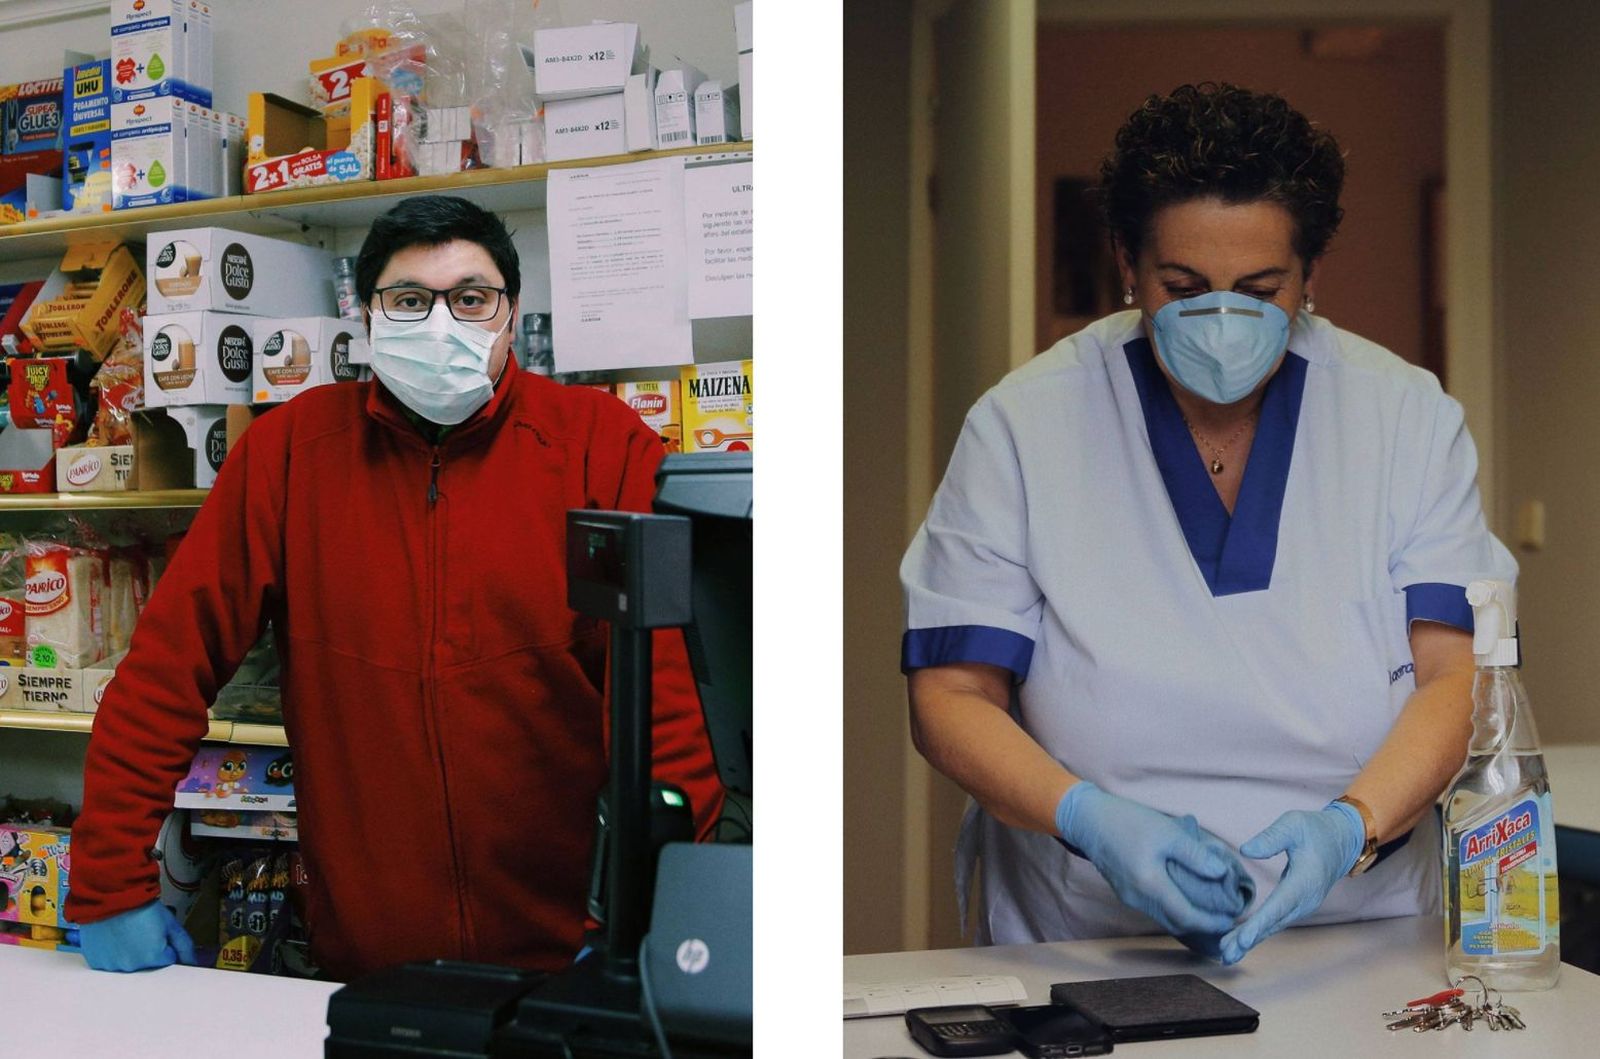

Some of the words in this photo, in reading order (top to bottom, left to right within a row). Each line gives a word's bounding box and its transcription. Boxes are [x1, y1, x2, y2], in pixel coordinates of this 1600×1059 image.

[588, 50, 605, 62] x12
[17, 79, 64, 97] LOCTITE
[76, 79, 99, 95] UHU
[73, 108, 105, 122] UNIVERSAL
[594, 120, 610, 131] x12
[253, 159, 290, 192] 2x1
[292, 161, 323, 176] GRATIS
[338, 162, 360, 175] SAL
[225, 262, 249, 279] Dolce
[225, 275, 250, 289] Gusto
[95, 268, 138, 333] TOBLERONE
[222, 345, 250, 359] Dolce
[222, 357, 250, 370] Gusto
[26, 364, 49, 378] JUICY
[635, 382, 659, 392] MAIZENA
[688, 374, 752, 399] MAIZENA
[211, 439, 226, 451] Do
[1465, 810, 1532, 862] ArriXaca
